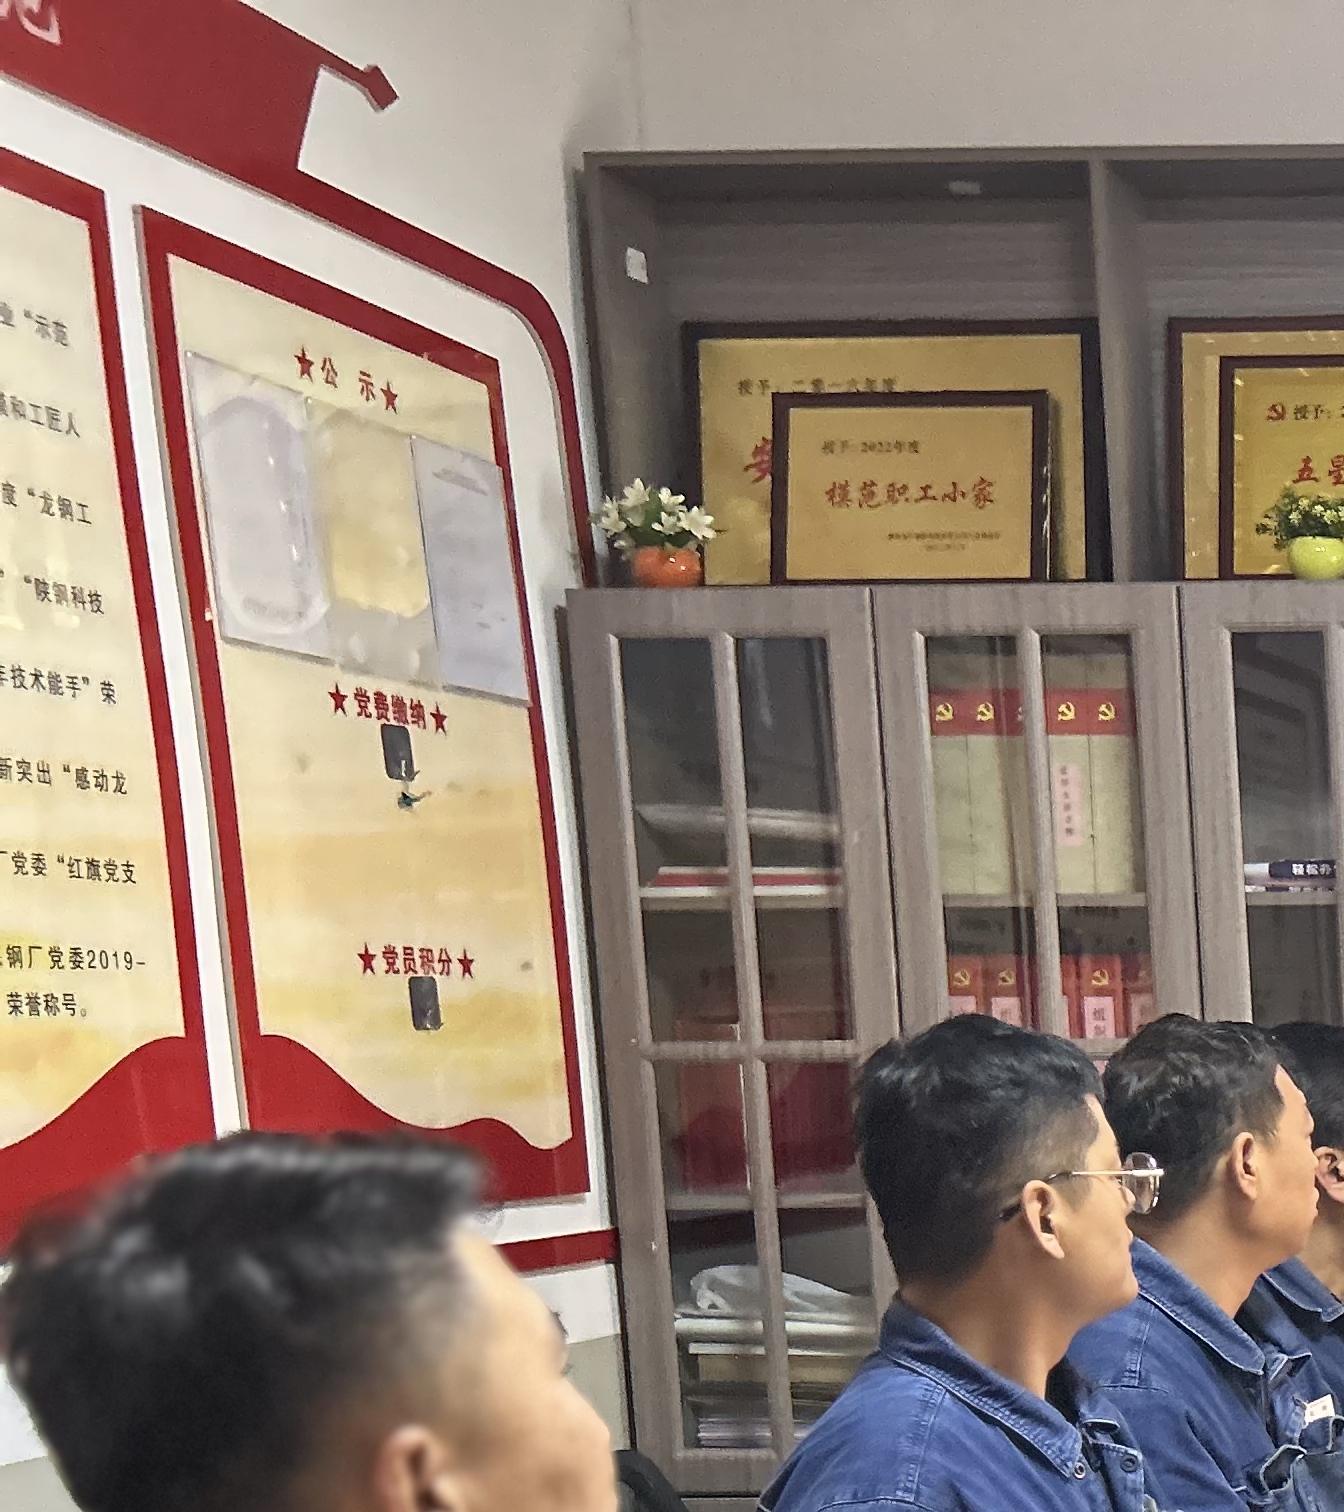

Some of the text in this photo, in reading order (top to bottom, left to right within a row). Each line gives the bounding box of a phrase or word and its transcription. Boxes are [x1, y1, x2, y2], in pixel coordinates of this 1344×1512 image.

[823, 477, 995, 509] 模范职工小家
[352, 686, 429, 731] 党费缴纳
[1292, 862, 1336, 876] 轻松办
[0, 945, 147, 972] 钢厂党委2019-
[381, 945, 454, 978] 党员积分
